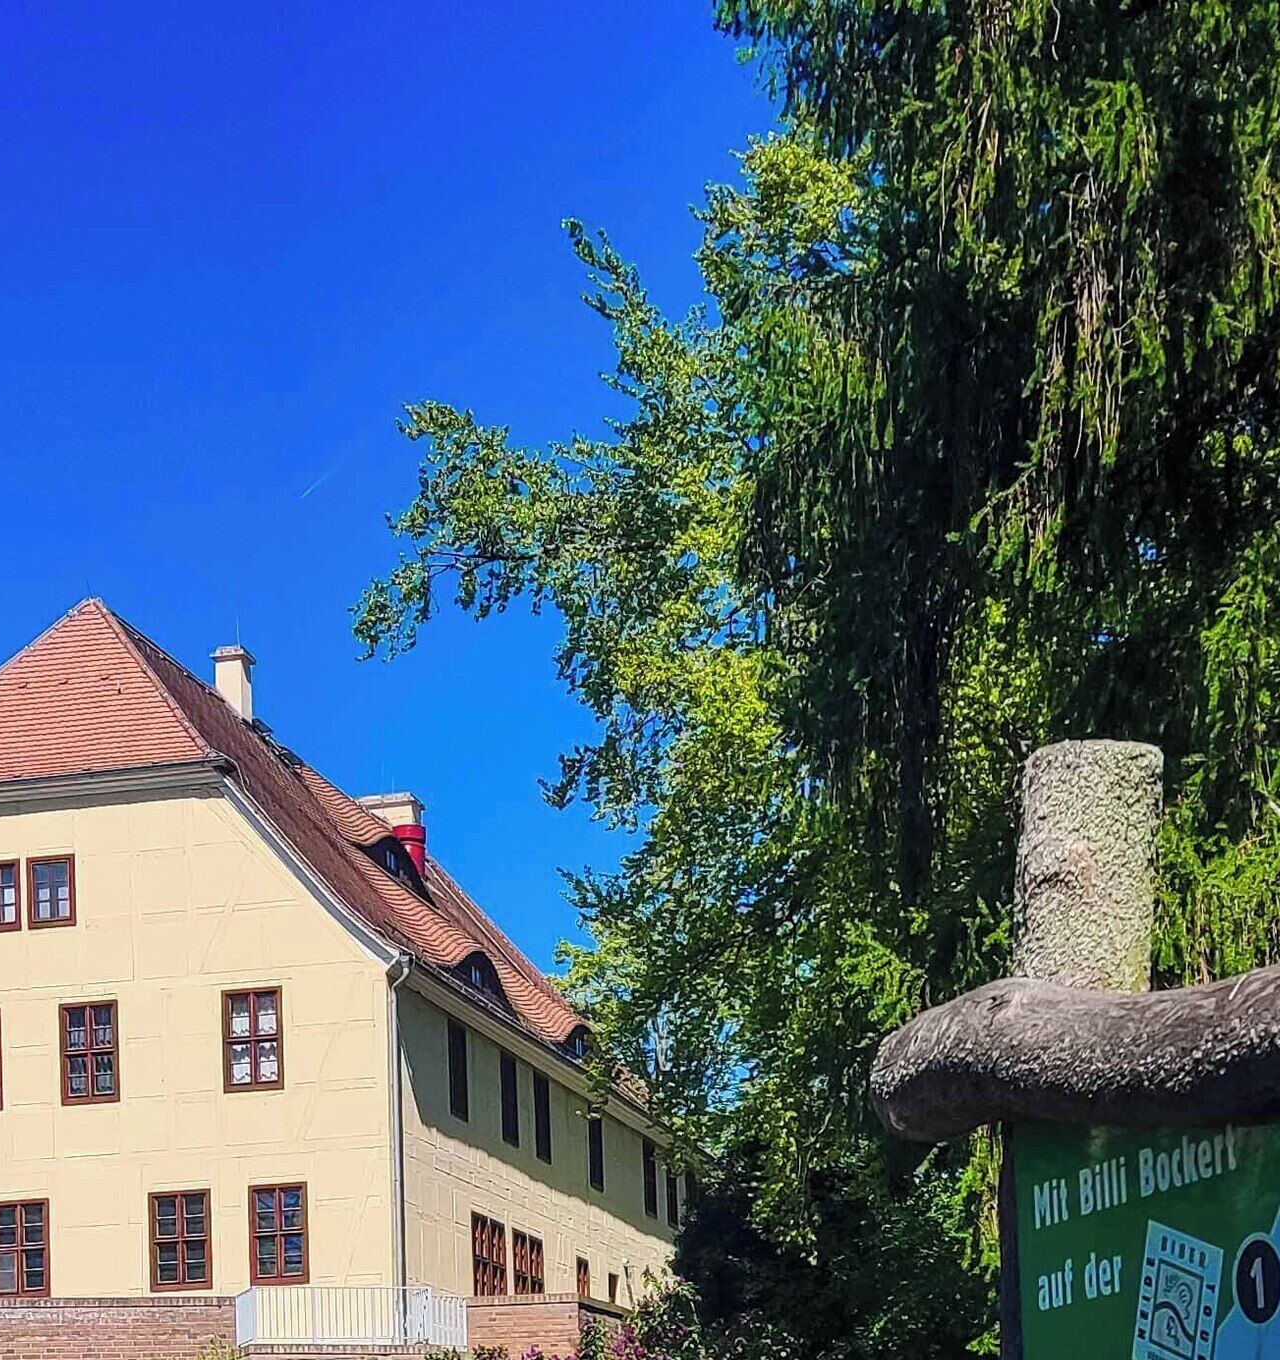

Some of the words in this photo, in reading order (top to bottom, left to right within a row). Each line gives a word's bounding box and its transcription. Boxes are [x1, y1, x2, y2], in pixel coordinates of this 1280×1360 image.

[1033, 1178, 1069, 1230] Mit
[1078, 1156, 1128, 1216] Billi
[1139, 1123, 1237, 1198] Bockert
[1160, 1234, 1207, 1270] BIBER
[1038, 1258, 1073, 1311] auf
[1084, 1252, 1122, 1300] der
[1250, 1256, 1265, 1309] 1
